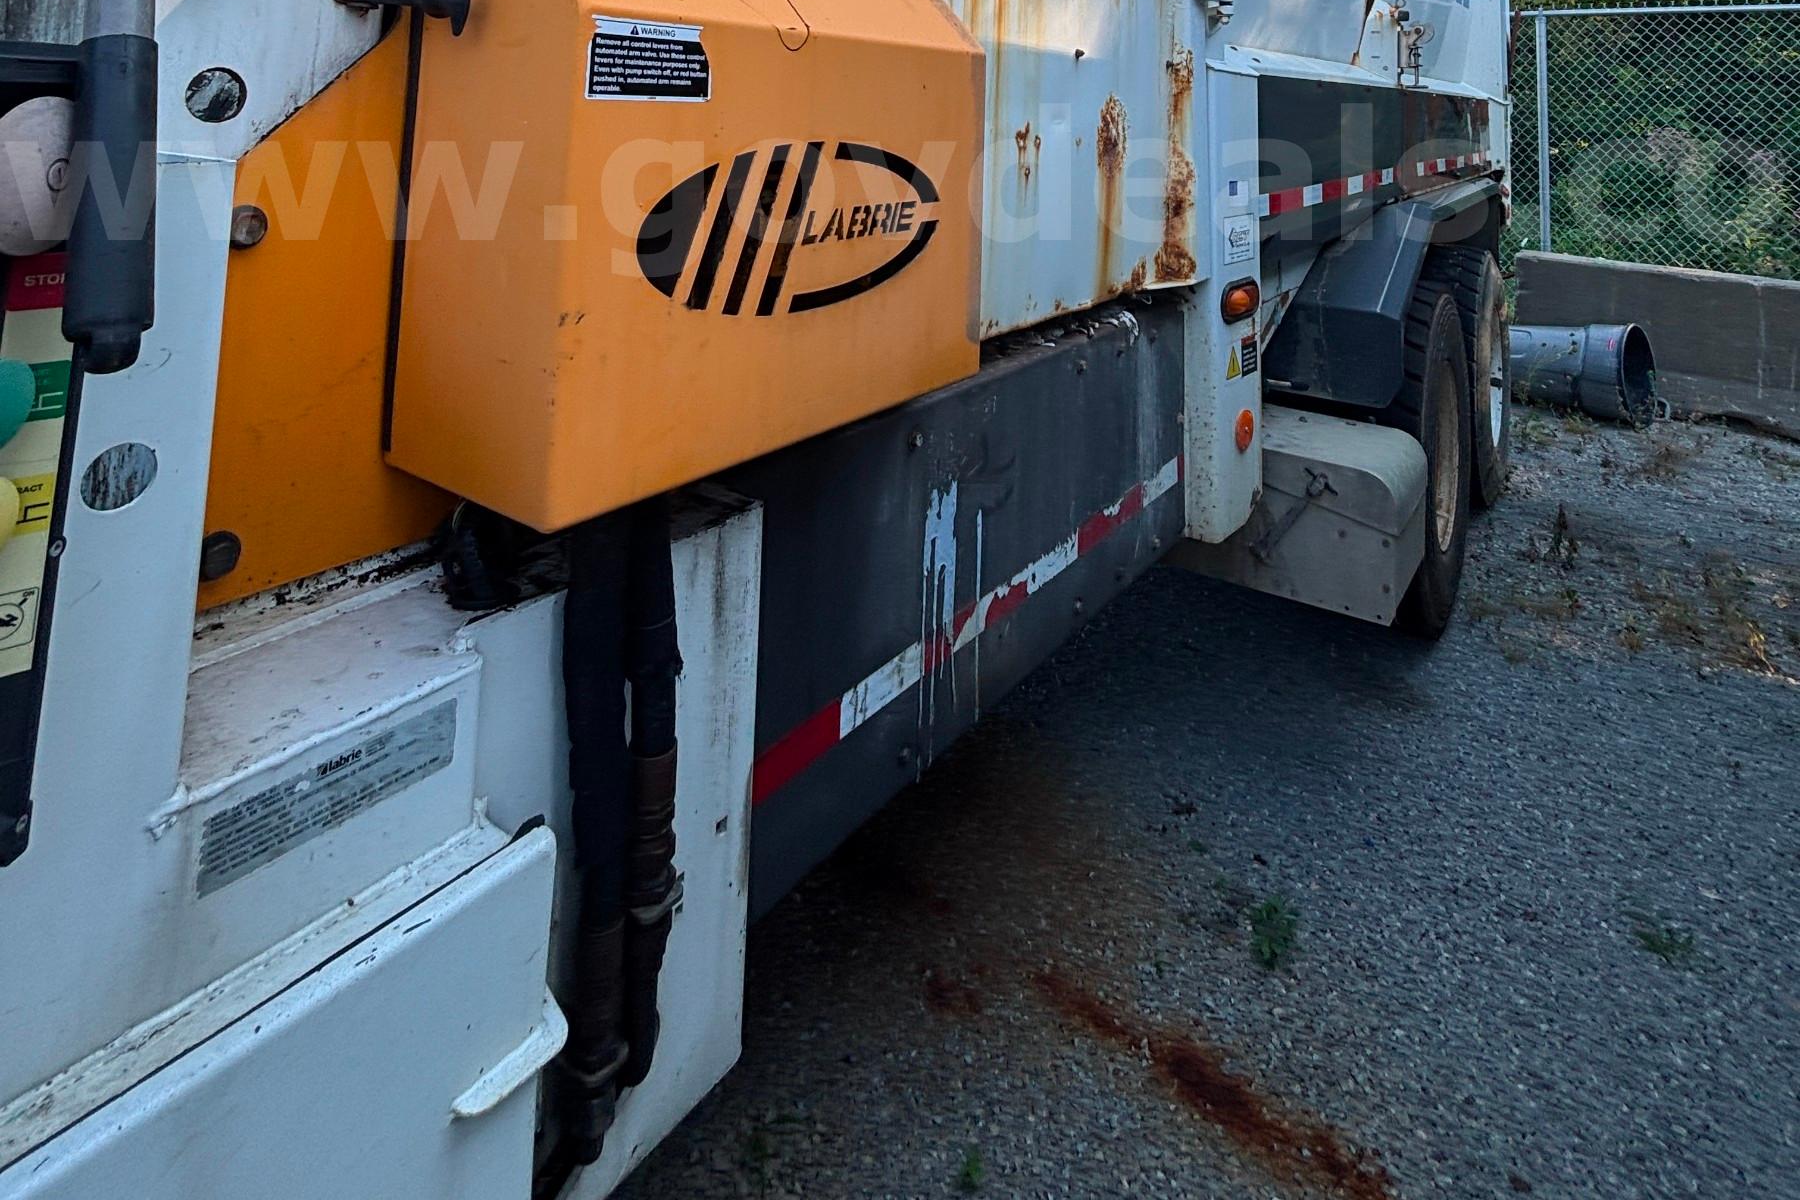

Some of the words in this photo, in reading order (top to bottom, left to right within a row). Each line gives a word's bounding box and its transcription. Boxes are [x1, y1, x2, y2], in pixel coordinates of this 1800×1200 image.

[640, 26, 676, 38] WARNING
[595, 36, 621, 46] Remove
[622, 39, 630, 47] all
[652, 42, 670, 50] levers
[670, 43, 684, 51] from
[594, 47, 628, 56] automated
[594, 55, 614, 64] levers
[614, 57, 625, 65] for
[624, 58, 662, 67] maintenance
[662, 61, 688, 69] purposes
[593, 64, 610, 73] Even
[610, 66, 625, 74] with
[625, 68, 643, 76] pump
[643, 68, 662, 76] switch
[593, 75, 617, 84] pushed
[627, 77, 658, 85] automated
[801, 200, 917, 246] LABRIE
[328, 748, 363, 772] labrie
